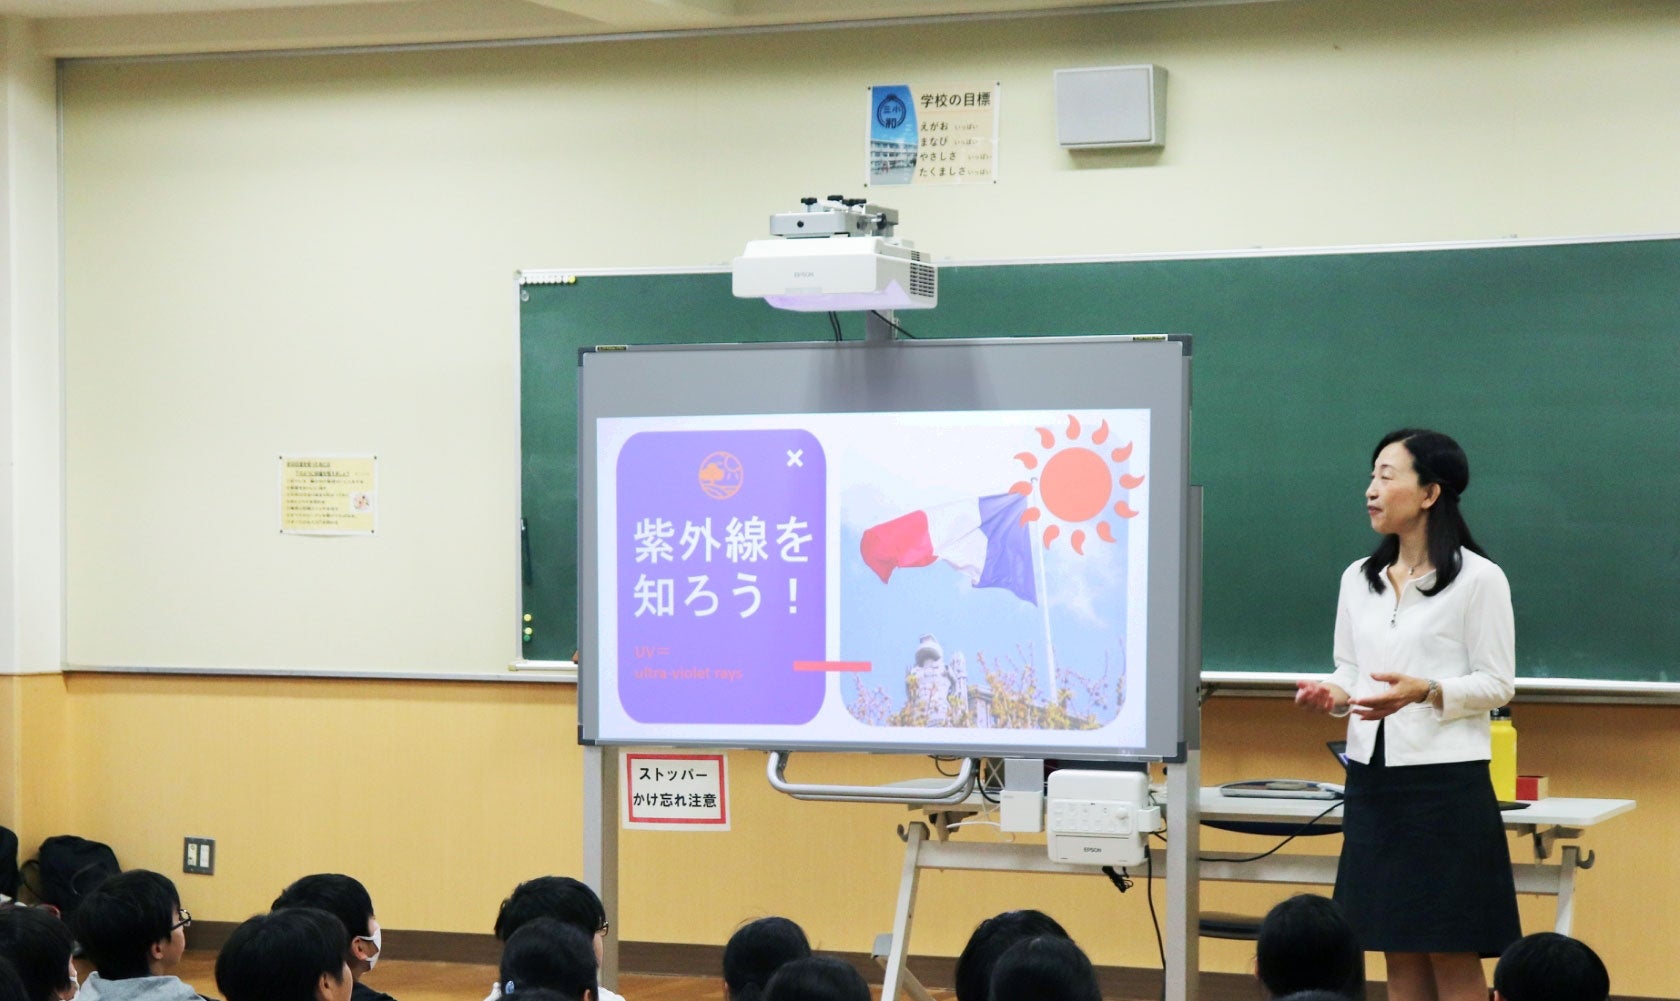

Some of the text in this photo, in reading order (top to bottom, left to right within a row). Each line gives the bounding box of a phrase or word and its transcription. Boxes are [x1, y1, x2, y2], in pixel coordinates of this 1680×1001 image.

[920, 91, 991, 107] 学校の目標
[920, 122, 949, 132] えがお
[920, 136, 949, 146] まなび
[919, 151, 957, 161] やさしさ
[919, 166, 966, 177] たくましさ
[633, 515, 813, 564] 紫外線を
[633, 572, 798, 619] 知ろう！
[714, 669, 744, 681] rays
[639, 767, 708, 781] ストッパー
[633, 792, 717, 808] かけ忘れ注意
